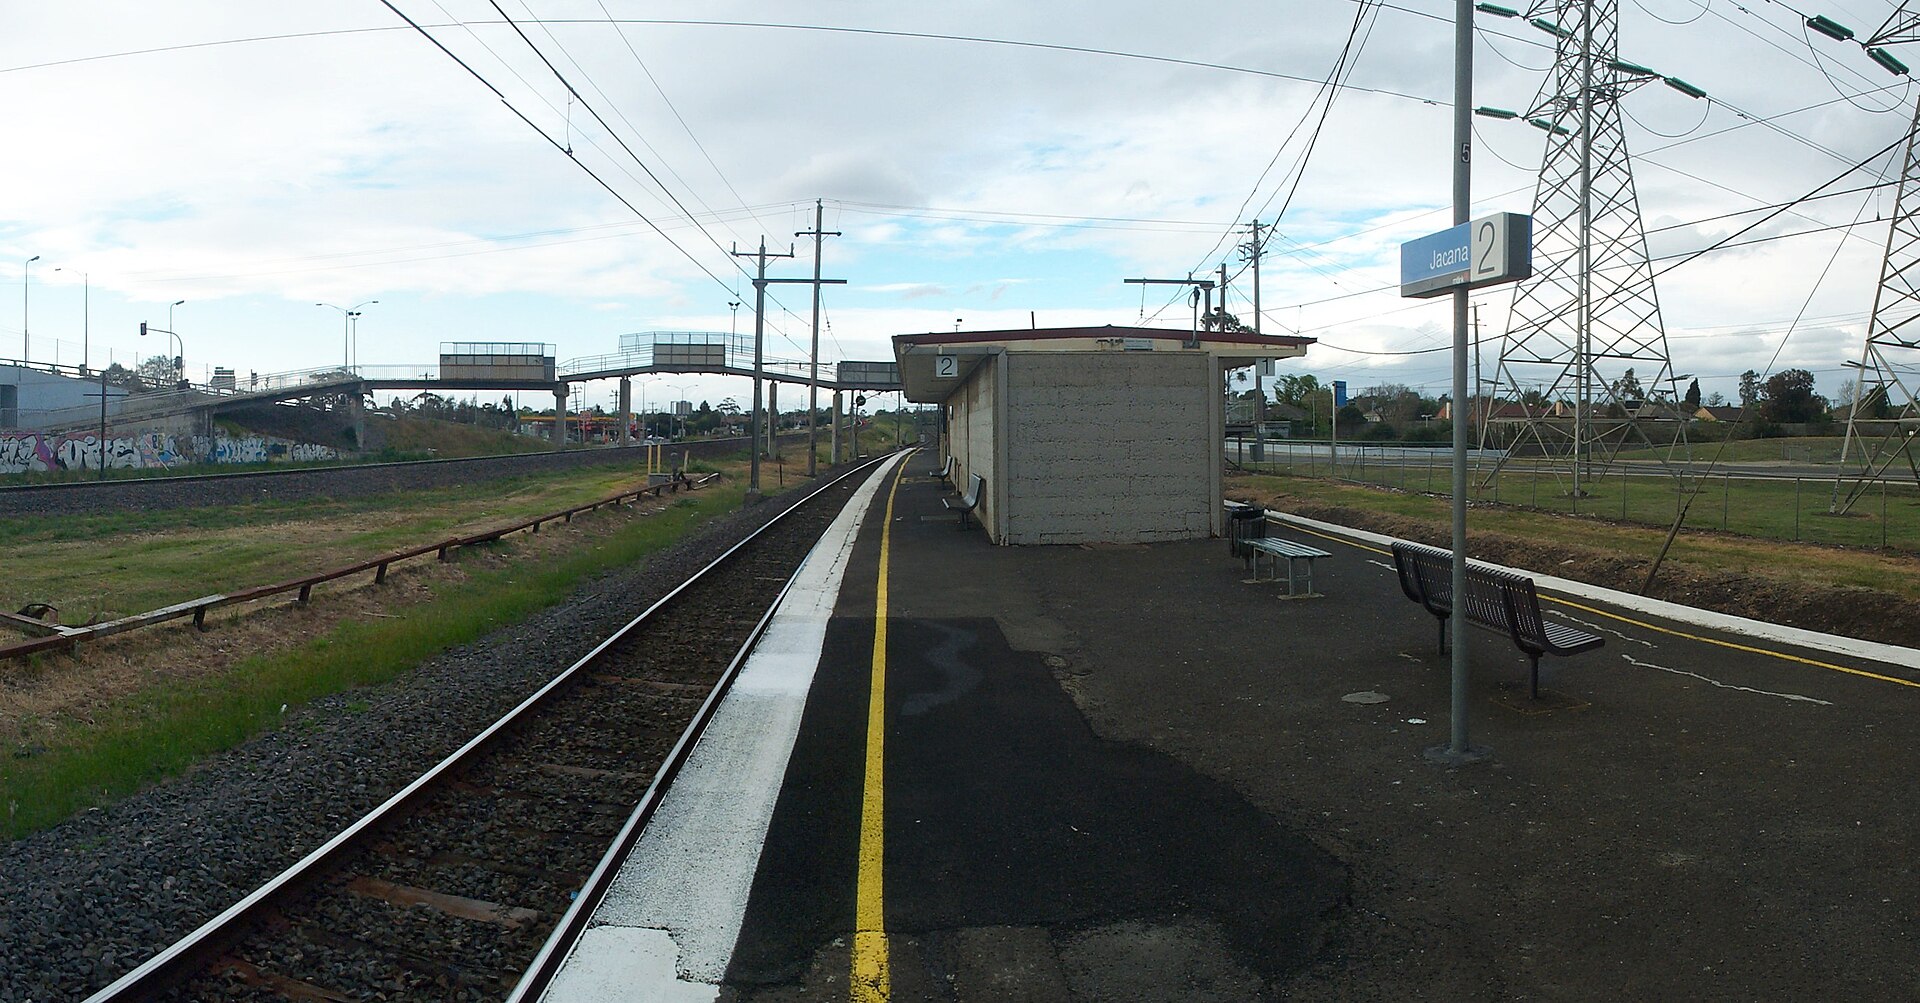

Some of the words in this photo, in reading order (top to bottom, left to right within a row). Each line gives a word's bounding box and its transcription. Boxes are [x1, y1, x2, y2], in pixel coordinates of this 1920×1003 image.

[1462, 143, 1470, 163] 5
[1429, 245, 1469, 270] Jacana
[1478, 221, 1495, 275] 2
[941, 357, 953, 375] 2
[1262, 357, 1269, 375] 1
